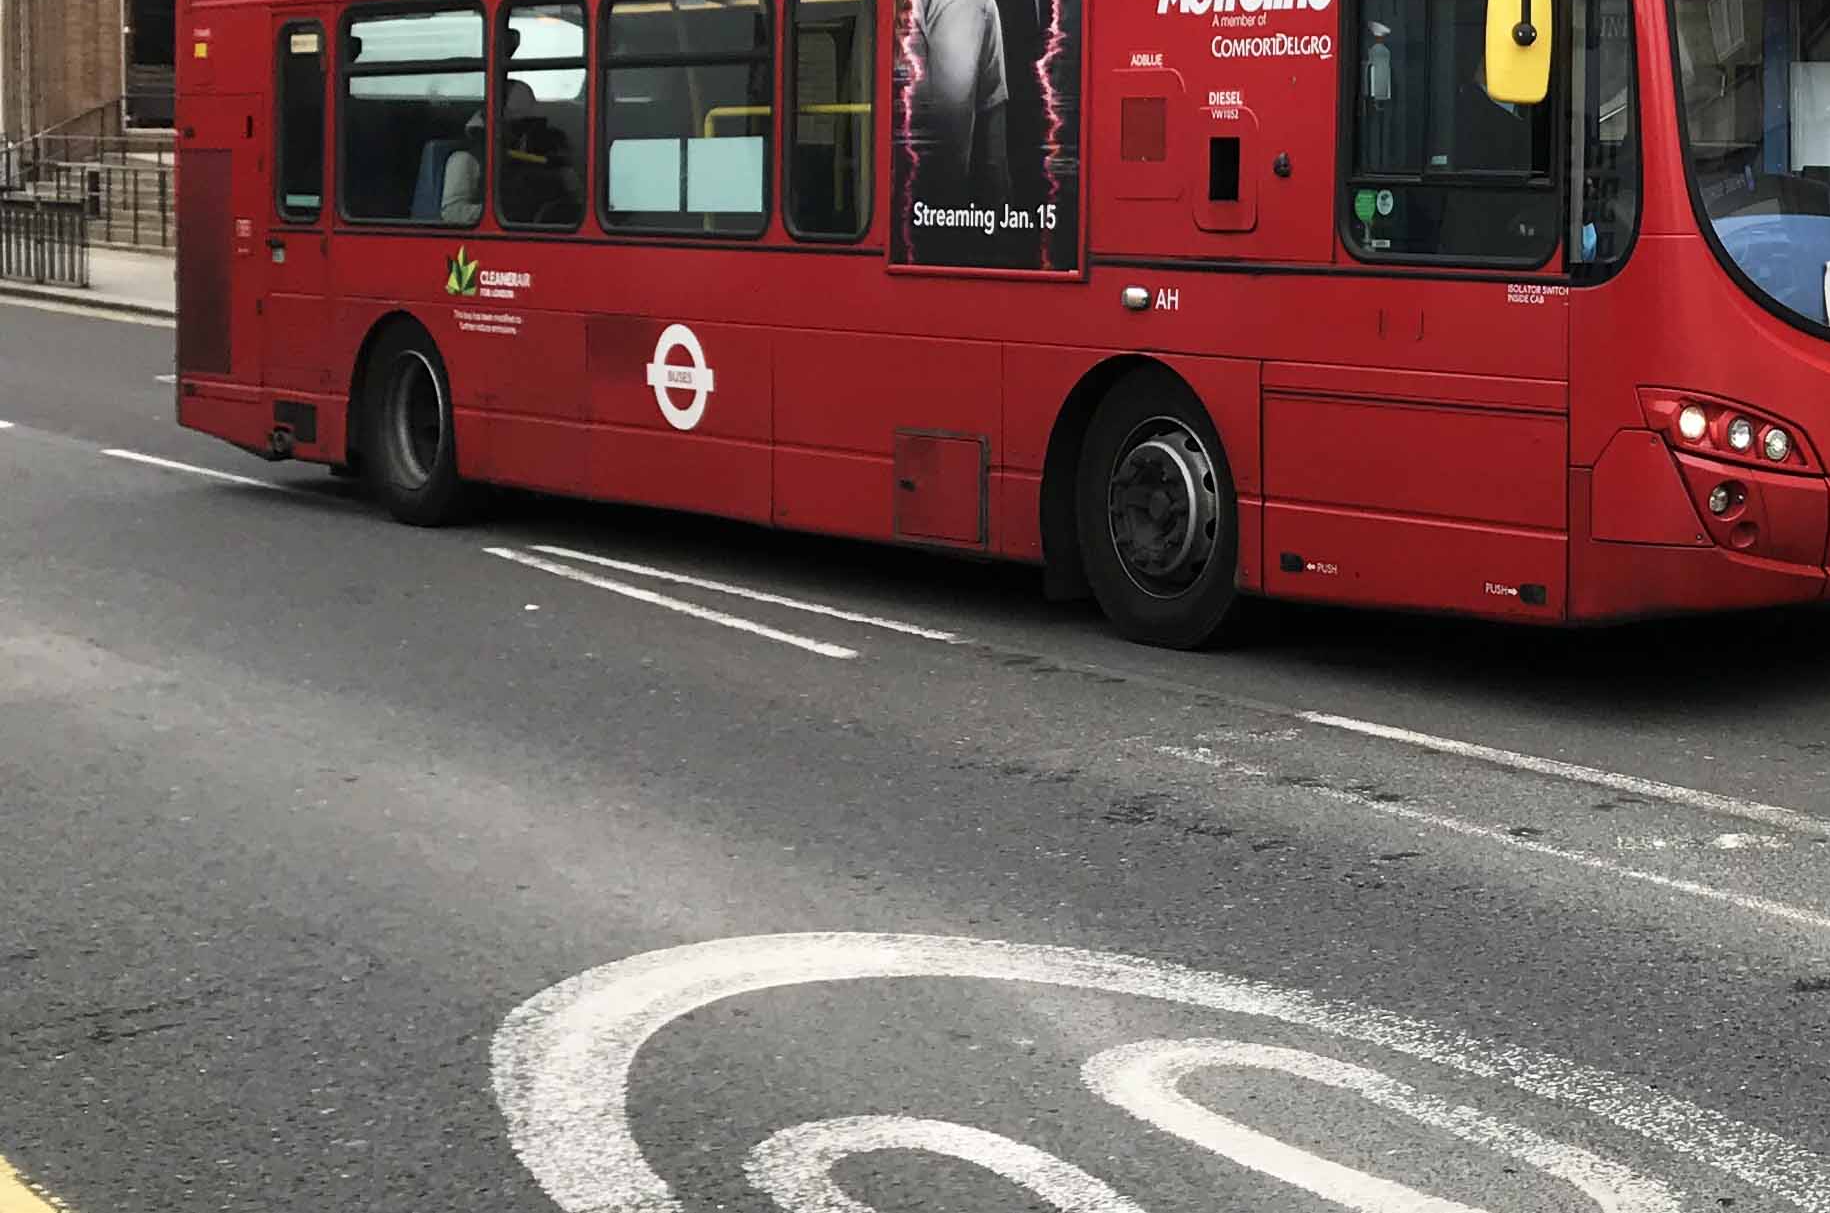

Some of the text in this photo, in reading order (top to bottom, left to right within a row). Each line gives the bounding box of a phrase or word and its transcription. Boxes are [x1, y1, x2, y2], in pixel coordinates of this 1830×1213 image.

[1211, 11, 1267, 27] A member of
[1130, 53, 1163, 67] ADBLUE
[1208, 91, 1243, 105] DIESEL
[912, 201, 1056, 236] Streaming Jan. 15
[1507, 284, 1569, 296] ISOLATOR SWITCH
[1154, 288, 1180, 311] AH
[667, 370, 693, 384] BUSES
[1316, 562, 1338, 575] PUSH
[1484, 582, 1508, 595] PUSH
